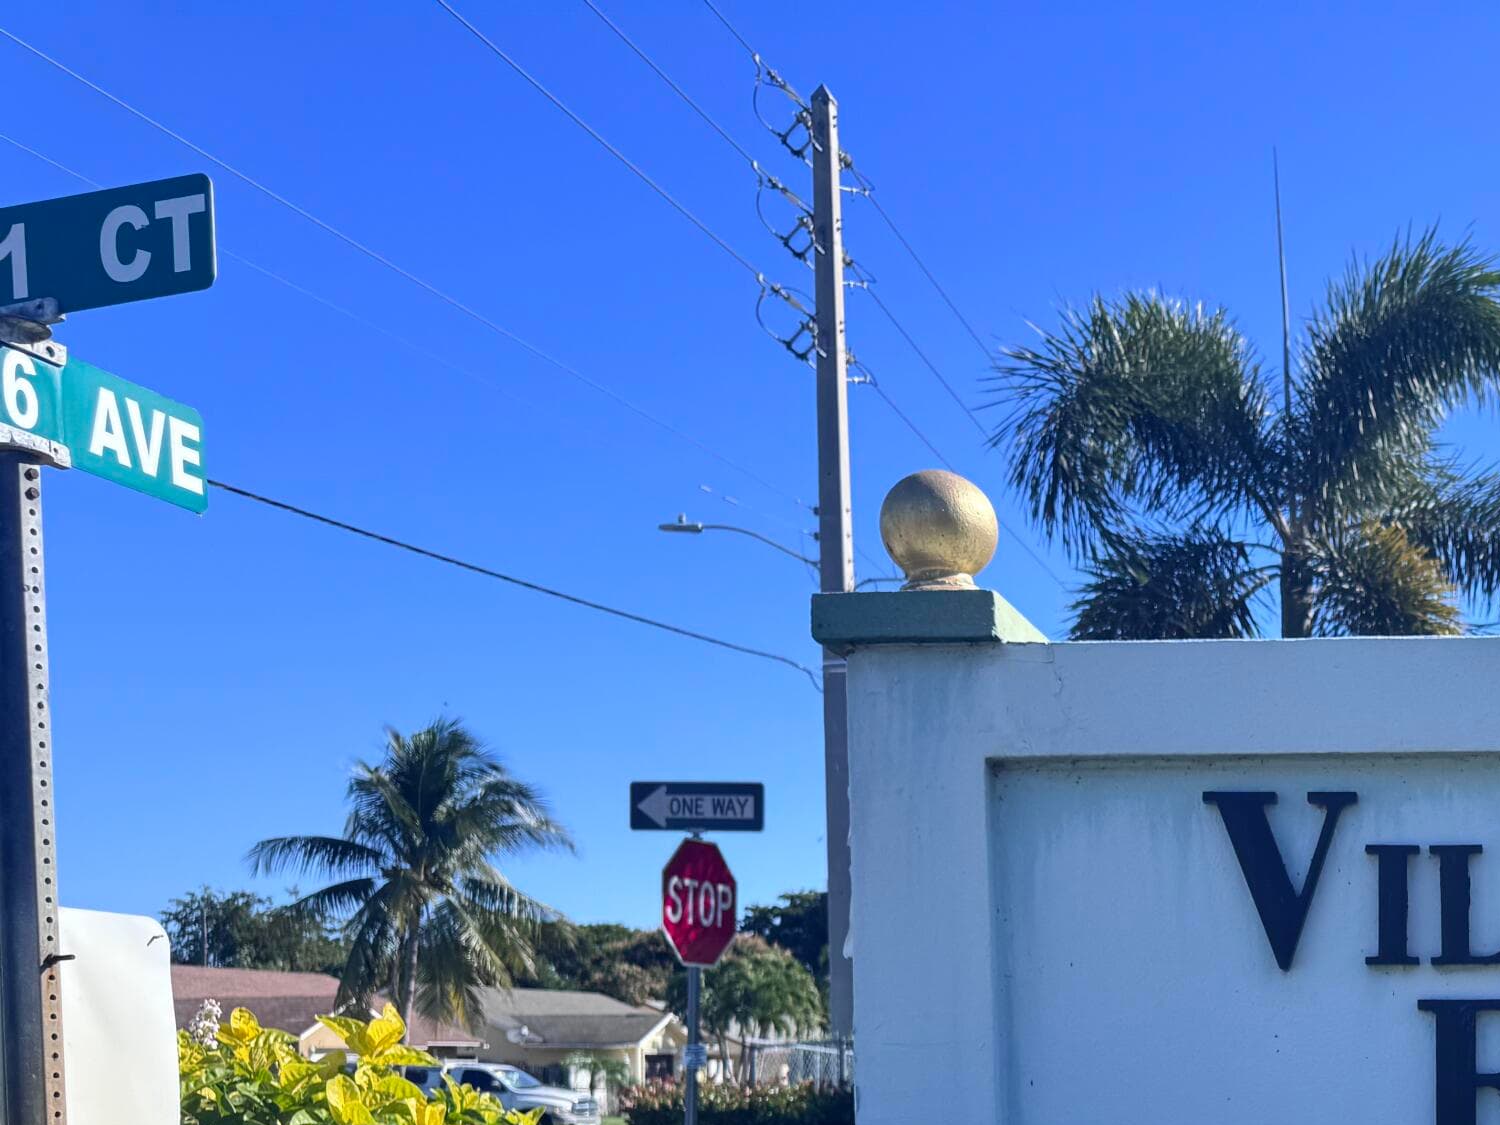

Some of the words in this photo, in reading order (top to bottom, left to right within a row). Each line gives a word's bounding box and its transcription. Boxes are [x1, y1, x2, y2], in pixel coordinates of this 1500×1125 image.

[0, 222, 29, 300] 1
[100, 193, 206, 283] CT
[2, 350, 39, 429] 6
[89, 386, 204, 496] AVE
[669, 797, 704, 816] ONE
[712, 798, 749, 817] WAY
[666, 875, 732, 929] STOP
